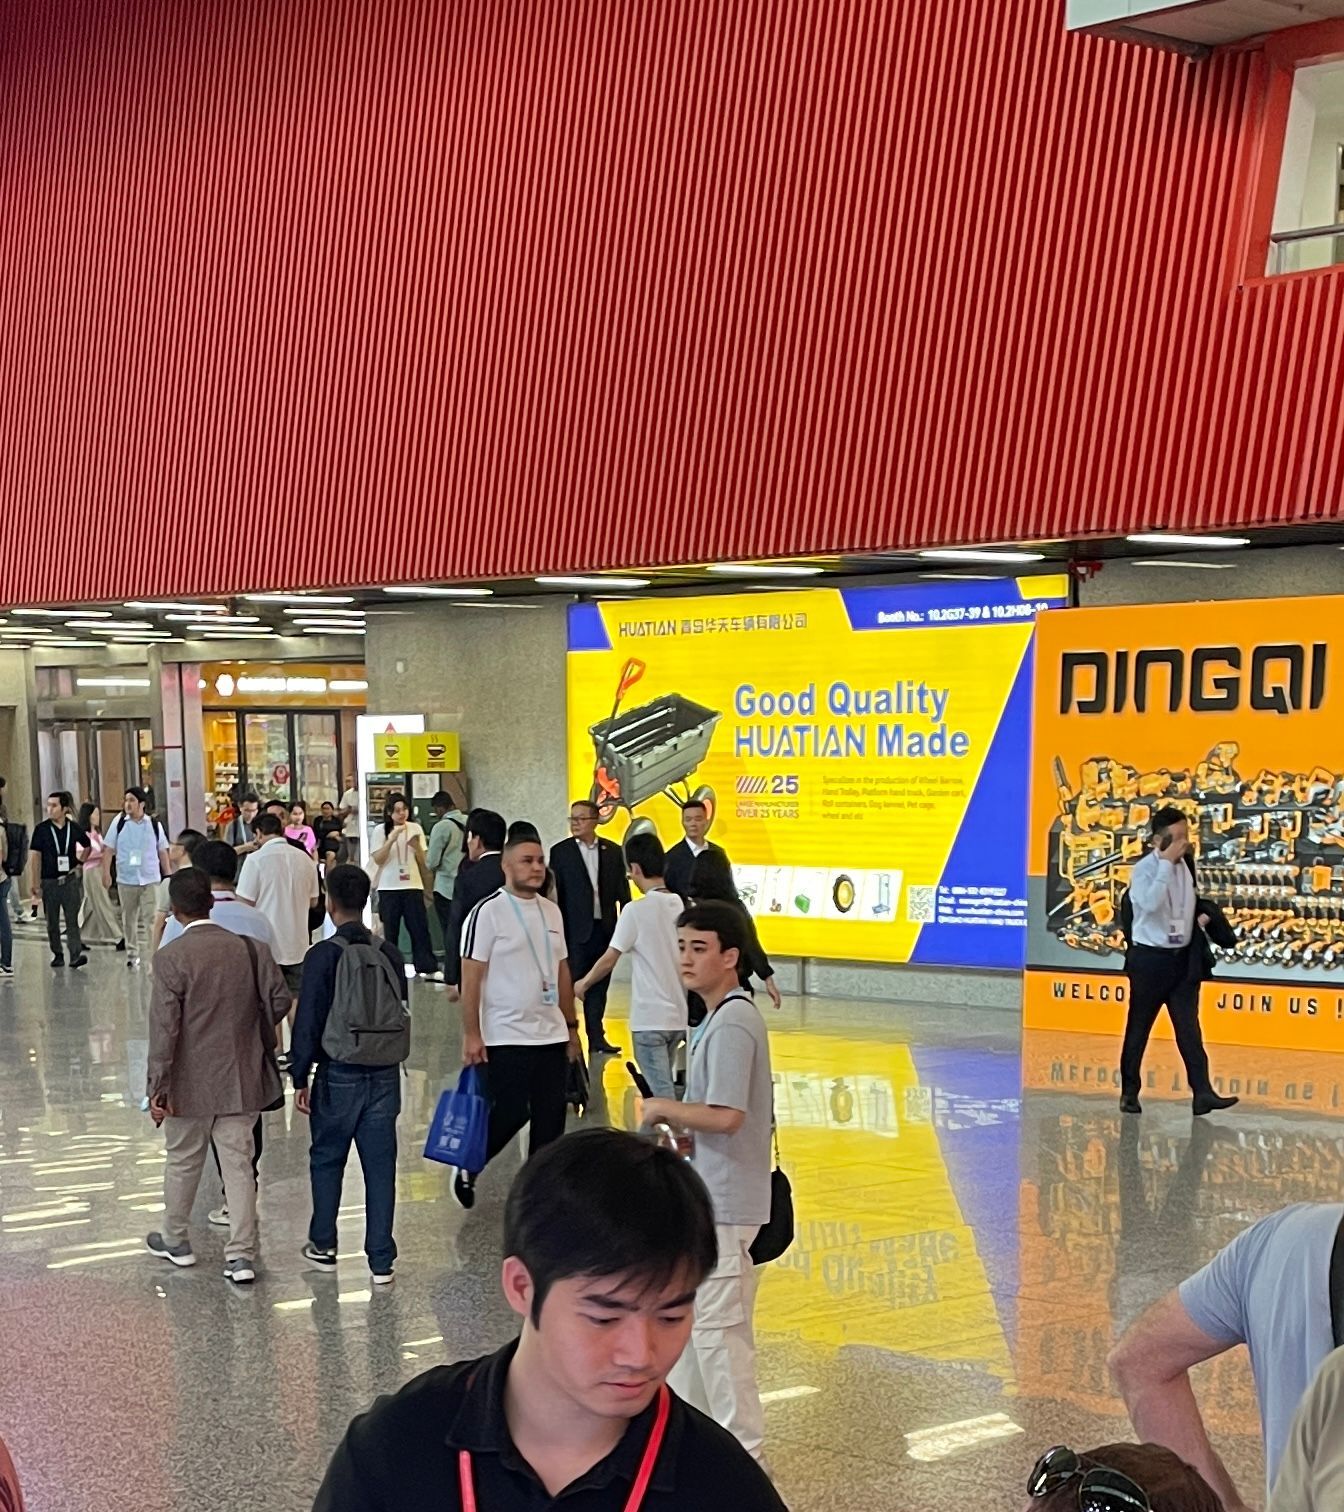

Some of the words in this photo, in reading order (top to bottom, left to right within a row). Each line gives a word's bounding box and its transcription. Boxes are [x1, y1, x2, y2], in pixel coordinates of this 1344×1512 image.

[619, 620, 677, 637] HUATIAN
[1060, 642, 1327, 714] DINGQI
[735, 683, 816, 716] Good
[827, 680, 950, 723] Quality
[735, 724, 867, 757] HUATIAN
[877, 723, 970, 757] Made
[771, 775, 799, 794] 25
[772, 809, 799, 818] YEARS
[1053, 982, 1125, 1002] WELCO
[1217, 993, 1273, 1013] JOIN
[1289, 997, 1319, 1016] US
